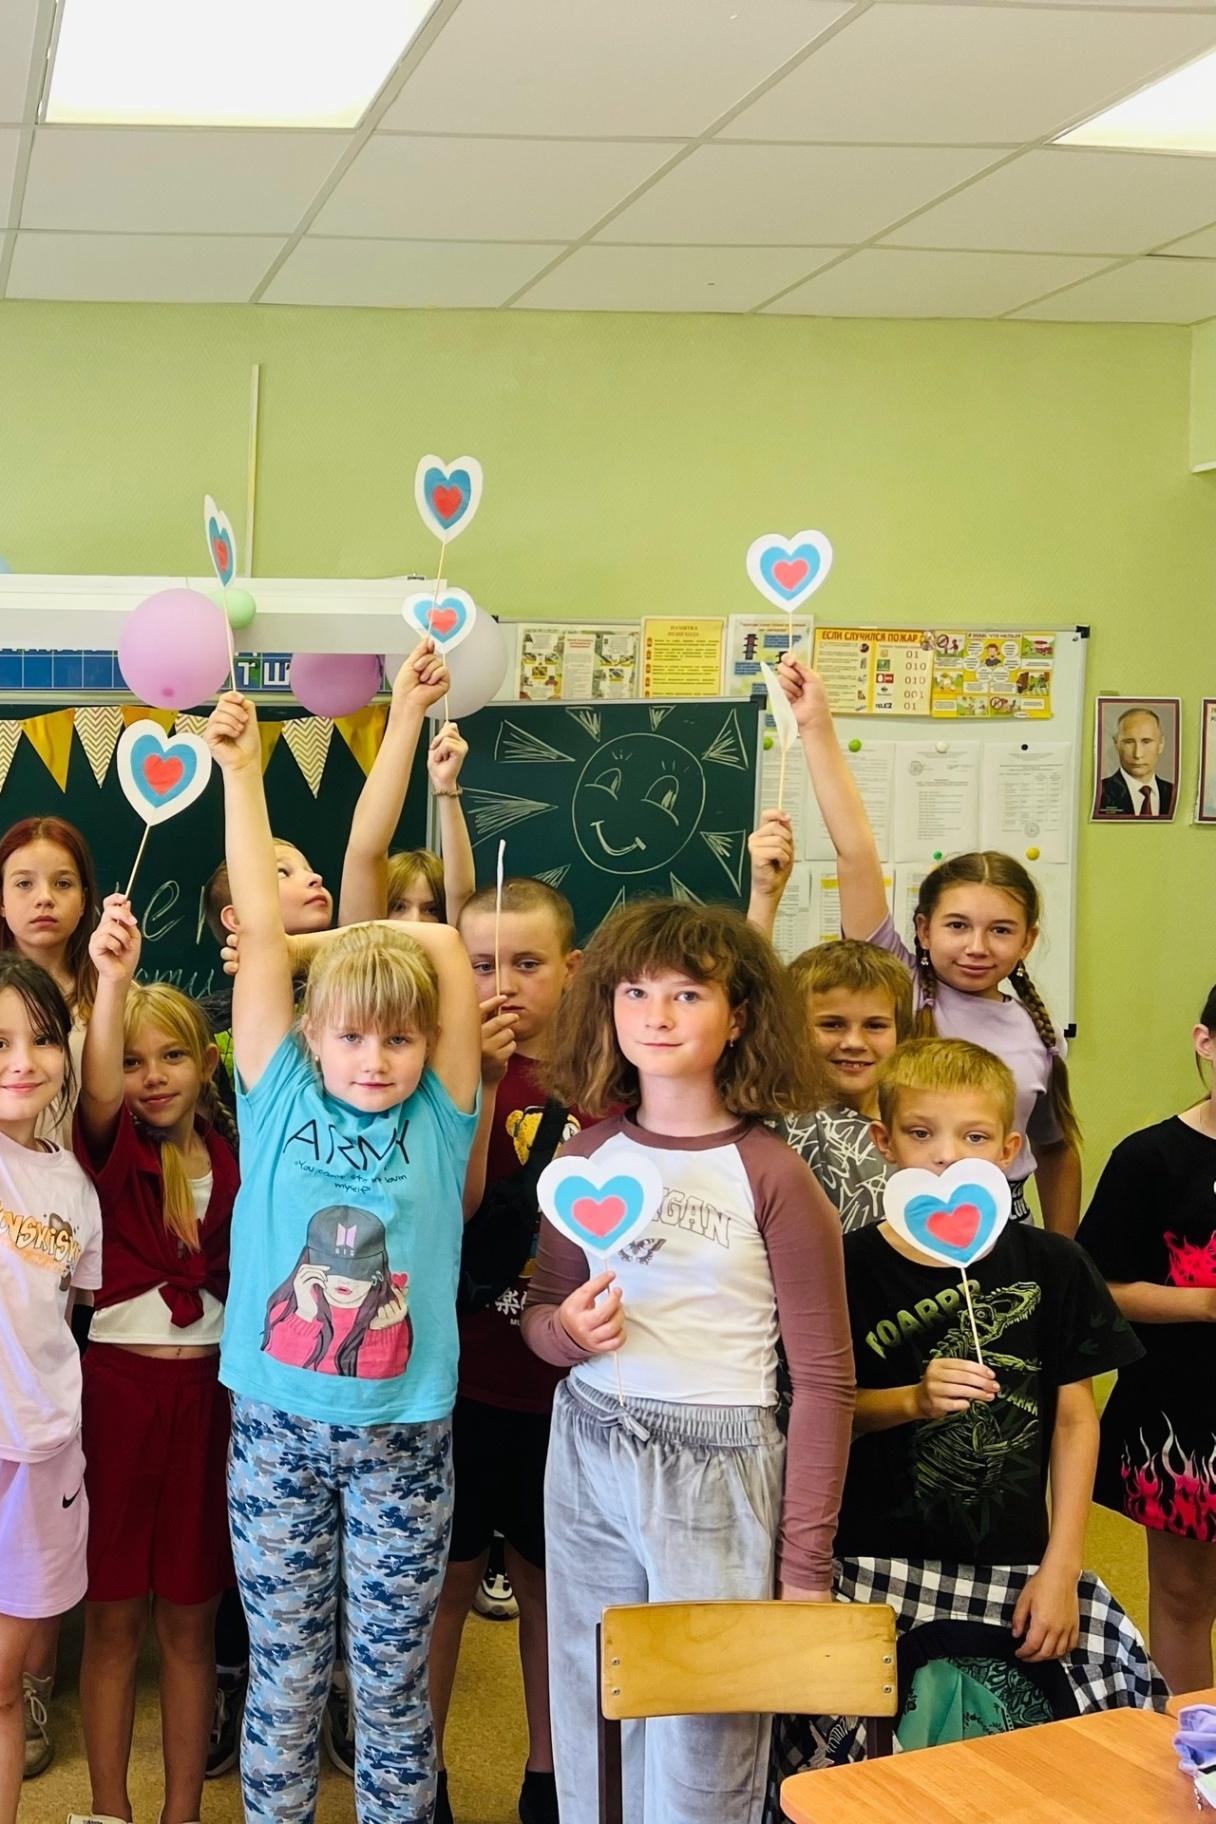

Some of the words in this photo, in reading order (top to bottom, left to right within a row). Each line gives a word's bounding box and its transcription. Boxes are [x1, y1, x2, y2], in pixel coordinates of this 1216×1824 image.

[822, 631, 843, 641] ЕСЛИ
[844, 631, 886, 642] СЛУЧИЛСЯ
[887, 632, 919, 643] ПОЖАР
[282, 1118, 410, 1171] ARMY
